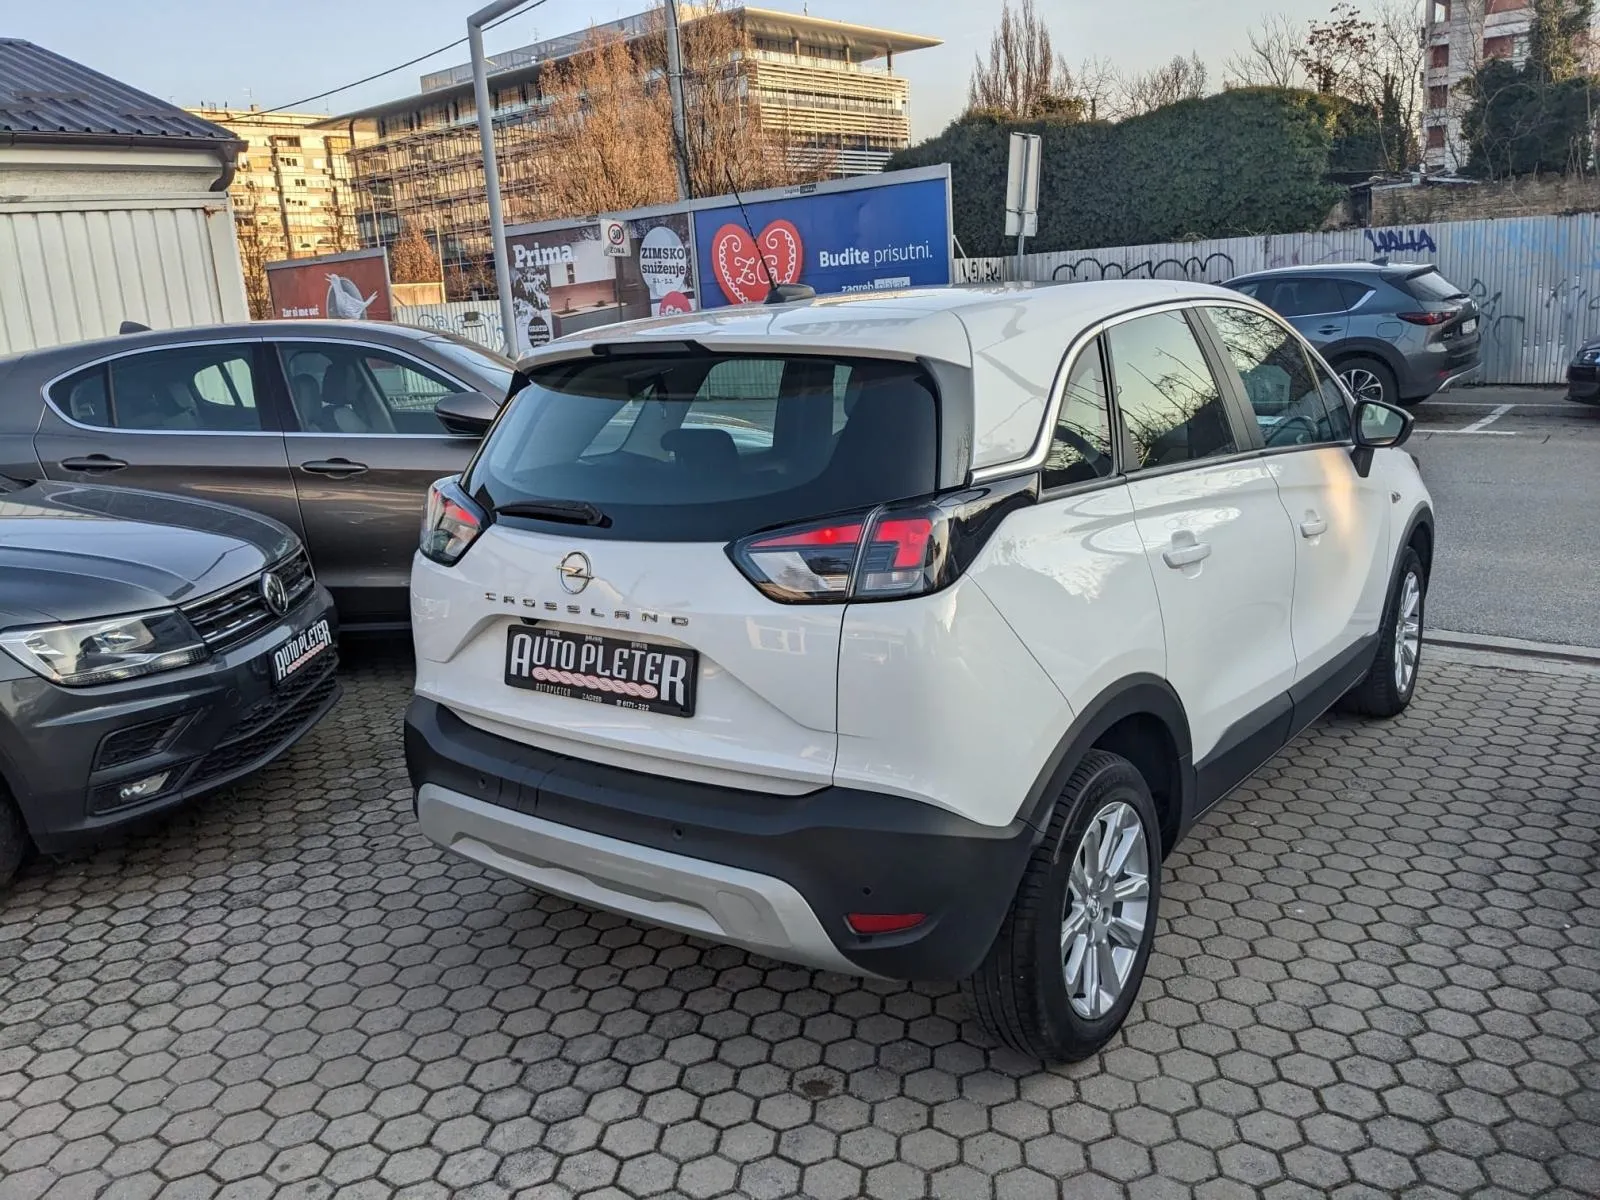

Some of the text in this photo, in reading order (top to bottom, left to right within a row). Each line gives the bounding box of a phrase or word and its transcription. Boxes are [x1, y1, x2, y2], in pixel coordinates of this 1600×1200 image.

[611, 229, 621, 240] 30
[610, 246, 625, 254] ZONA
[641, 247, 685, 260] ZIMSKO
[820, 240, 933, 269] Budite prisutni.
[641, 260, 685, 278] sniženje
[485, 592, 689, 627] CROSSLAND
[582, 693, 603, 703] ZAGREB
